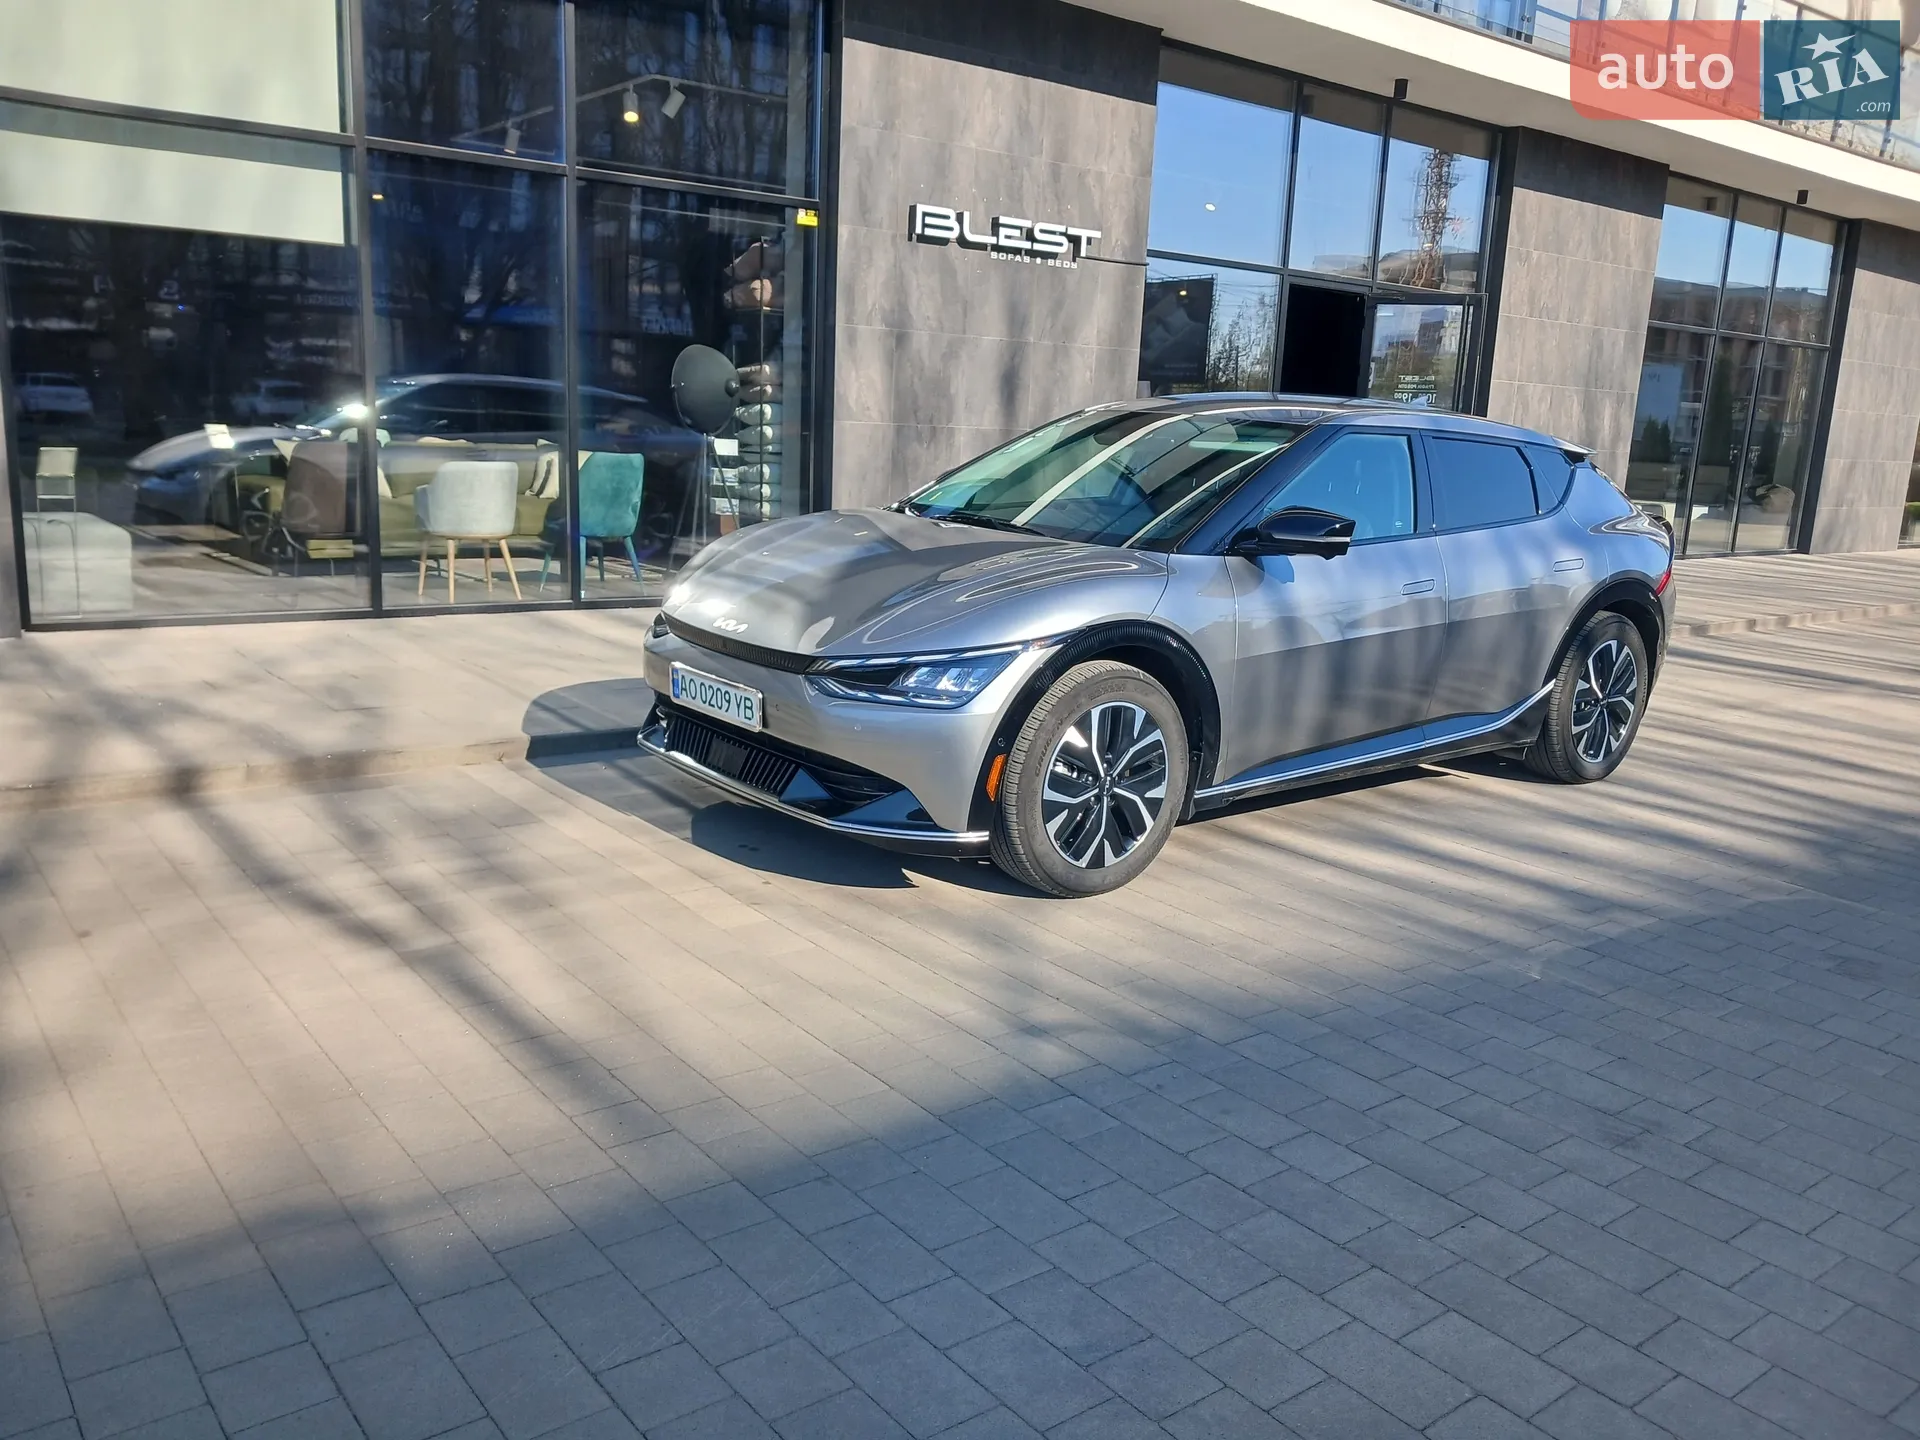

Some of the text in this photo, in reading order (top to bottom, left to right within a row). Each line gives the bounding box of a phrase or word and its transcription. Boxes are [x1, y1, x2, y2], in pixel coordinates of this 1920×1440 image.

[914, 203, 1102, 257] BLEST
[990, 251, 1031, 264] SOFAS
[1047, 258, 1078, 269] BEDS
[680, 674, 755, 721] AO 0209 YB
